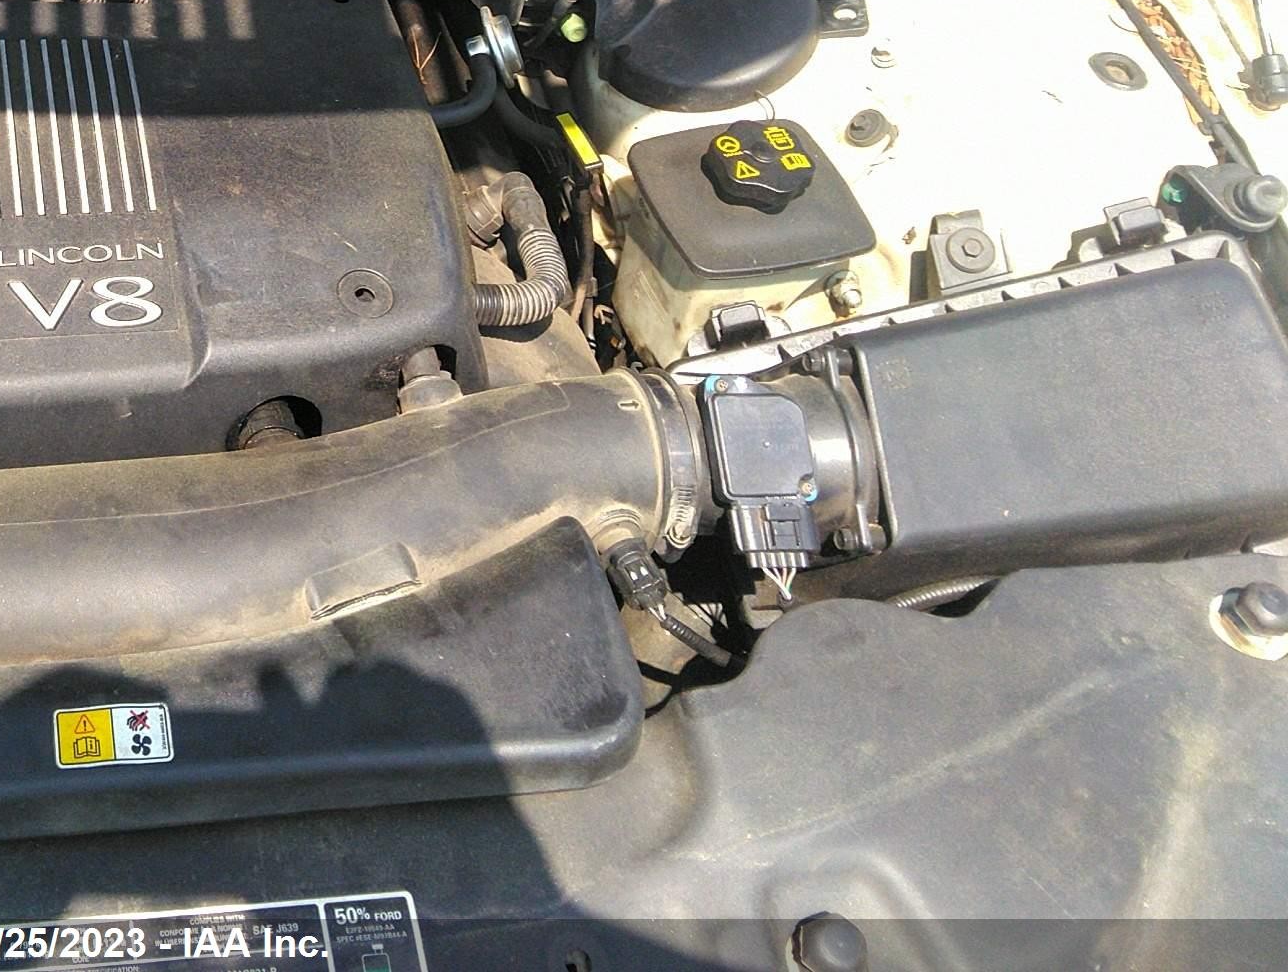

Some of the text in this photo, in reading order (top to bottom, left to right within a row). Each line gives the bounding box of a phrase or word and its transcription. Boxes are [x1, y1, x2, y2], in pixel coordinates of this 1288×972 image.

[7, 276, 164, 331] V8
[333, 906, 403, 925] 50% FORD
[276, 923, 299, 934] J639
